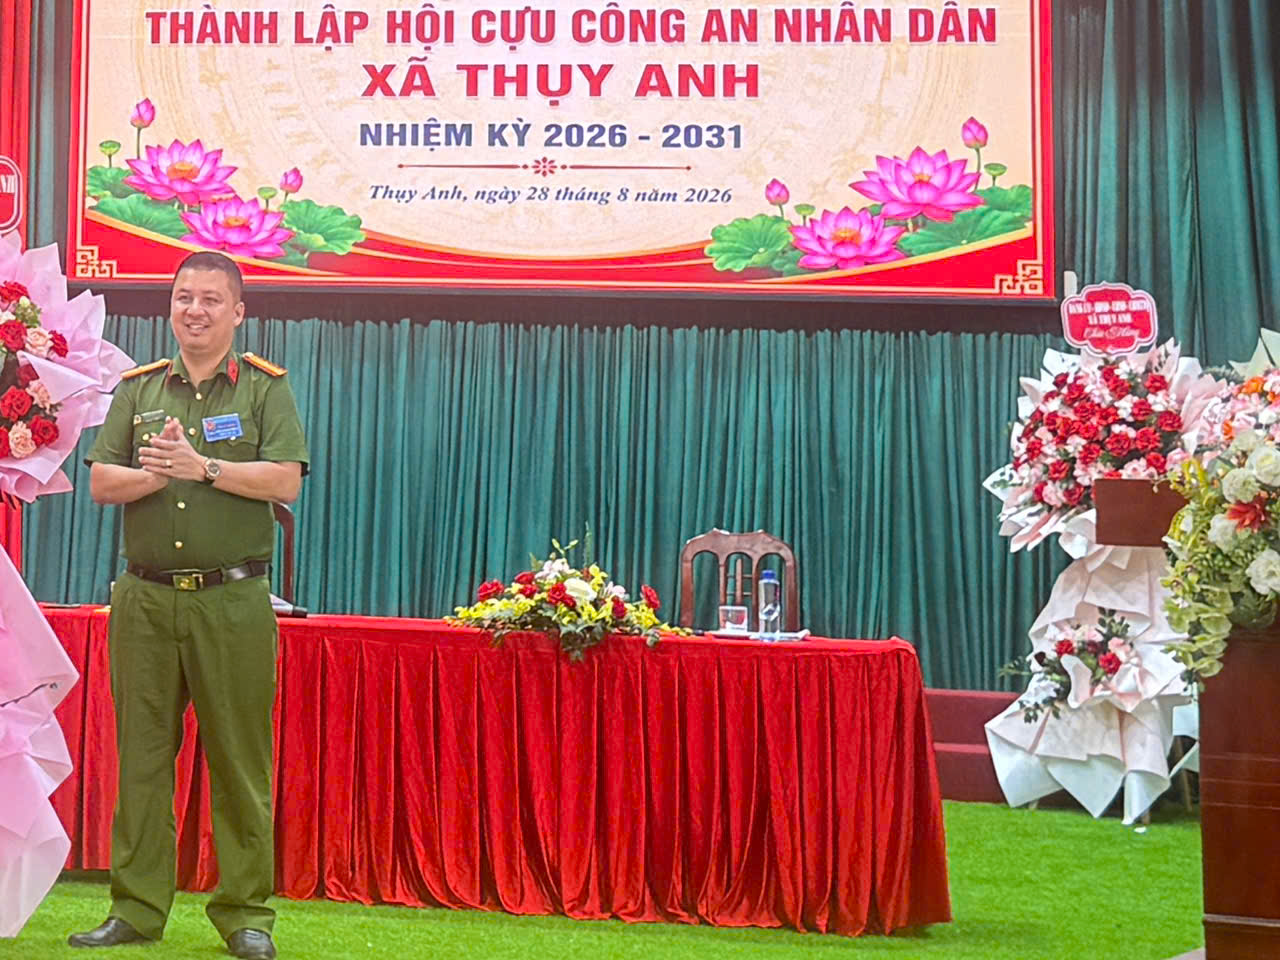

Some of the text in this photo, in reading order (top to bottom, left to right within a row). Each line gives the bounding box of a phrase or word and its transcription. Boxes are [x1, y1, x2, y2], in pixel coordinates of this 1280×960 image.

[145, 1, 997, 51] THÀNH LẬP HỘI CỰU CÔNG AN NHÂN DÂN
[361, 56, 759, 107] XÃ THỤY ANH
[359, 117, 473, 152] NHIỆM
[487, 117, 532, 147] KỲ
[543, 123, 628, 148] 2026
[661, 124, 742, 149] 2031
[369, 185, 733, 205] Thụy Anh, ngày 28 tháng 8 năm 2026
